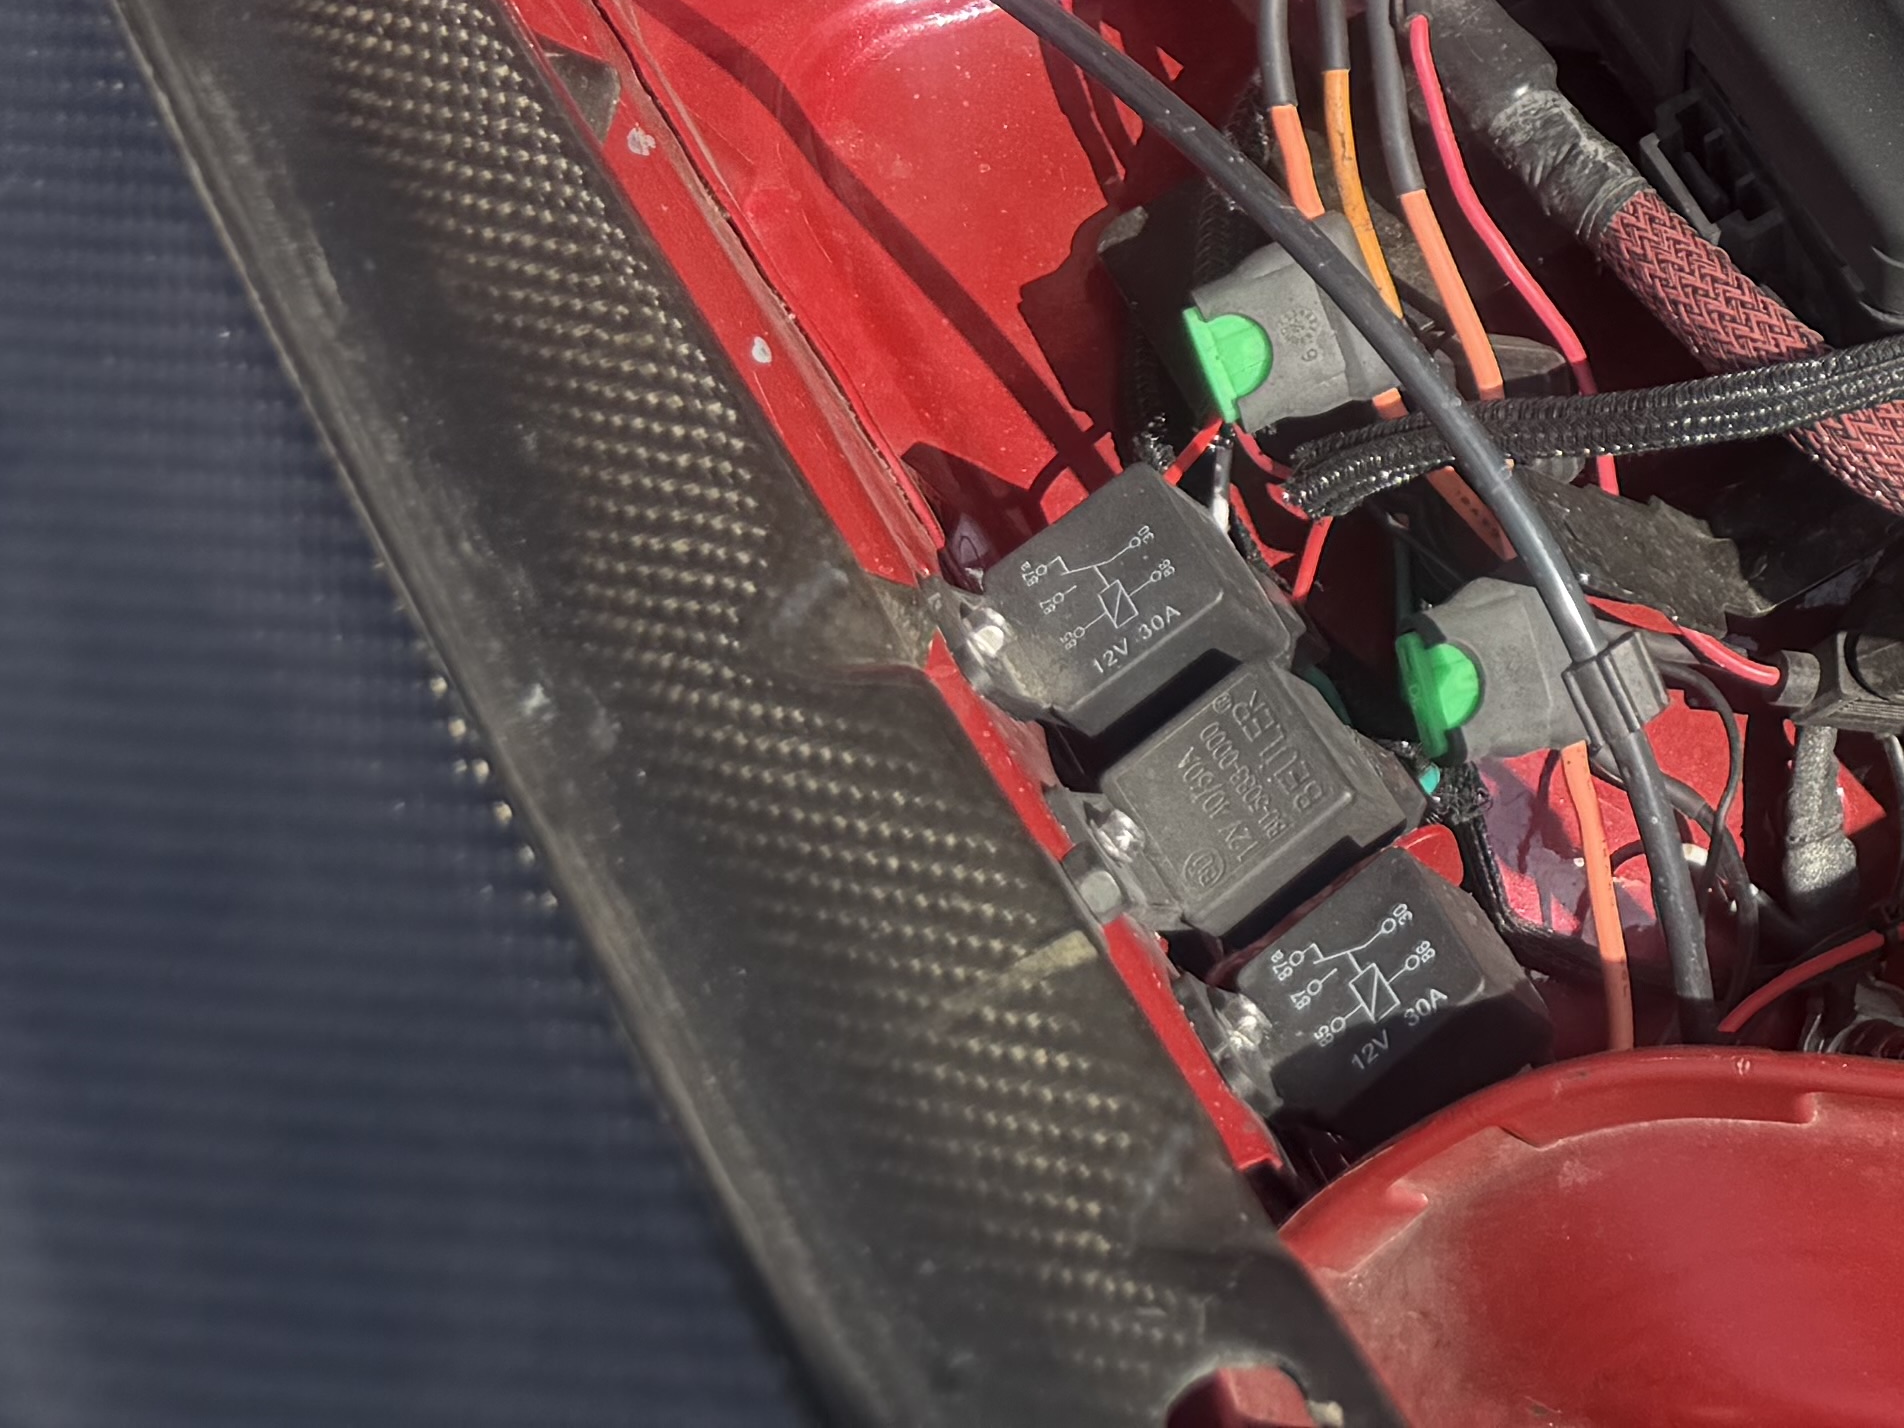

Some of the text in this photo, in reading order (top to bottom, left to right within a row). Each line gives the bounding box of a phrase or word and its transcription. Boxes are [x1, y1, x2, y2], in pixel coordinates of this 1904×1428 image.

[1093, 604, 1181, 674] 12V 30A
[1218, 819, 1259, 863] 12V
[1392, 903, 1413, 927] 30
[1415, 940, 1437, 964] 86
[1289, 989, 1312, 1011] 87
[1350, 987, 1449, 1071] 12V 30A
